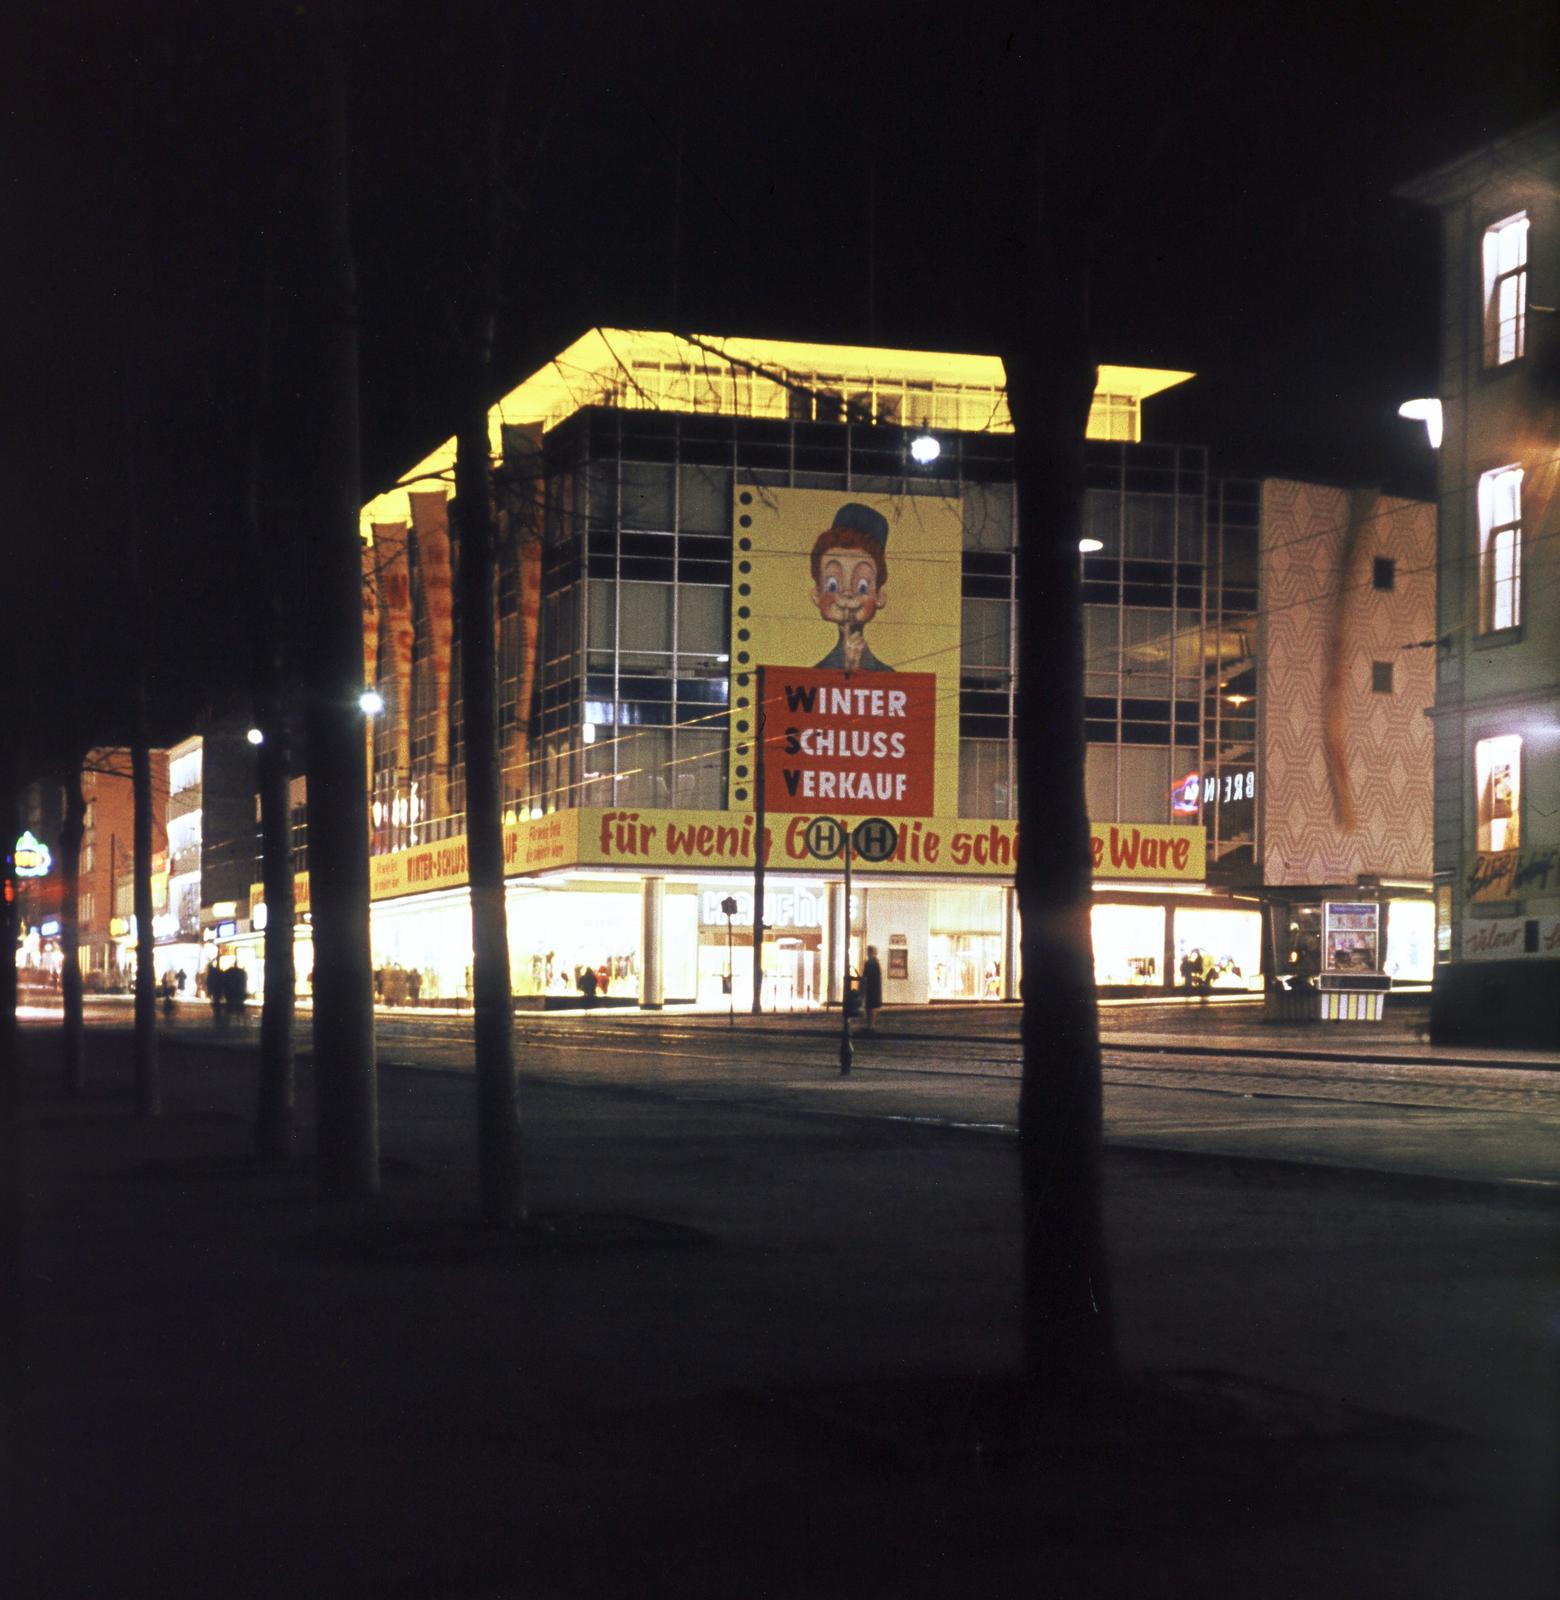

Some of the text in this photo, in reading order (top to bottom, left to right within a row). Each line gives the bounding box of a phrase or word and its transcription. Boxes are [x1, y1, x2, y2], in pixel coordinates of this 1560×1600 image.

[785, 686, 907, 717] WINTER
[784, 727, 906, 759] SCHLUSS
[783, 769, 907, 801] VERKAUF
[599, 811, 656, 856] Für
[951, 825, 1104, 870] sche
[1109, 826, 1190, 871] Ware
[814, 825, 835, 851] H
[864, 827, 887, 853] H
